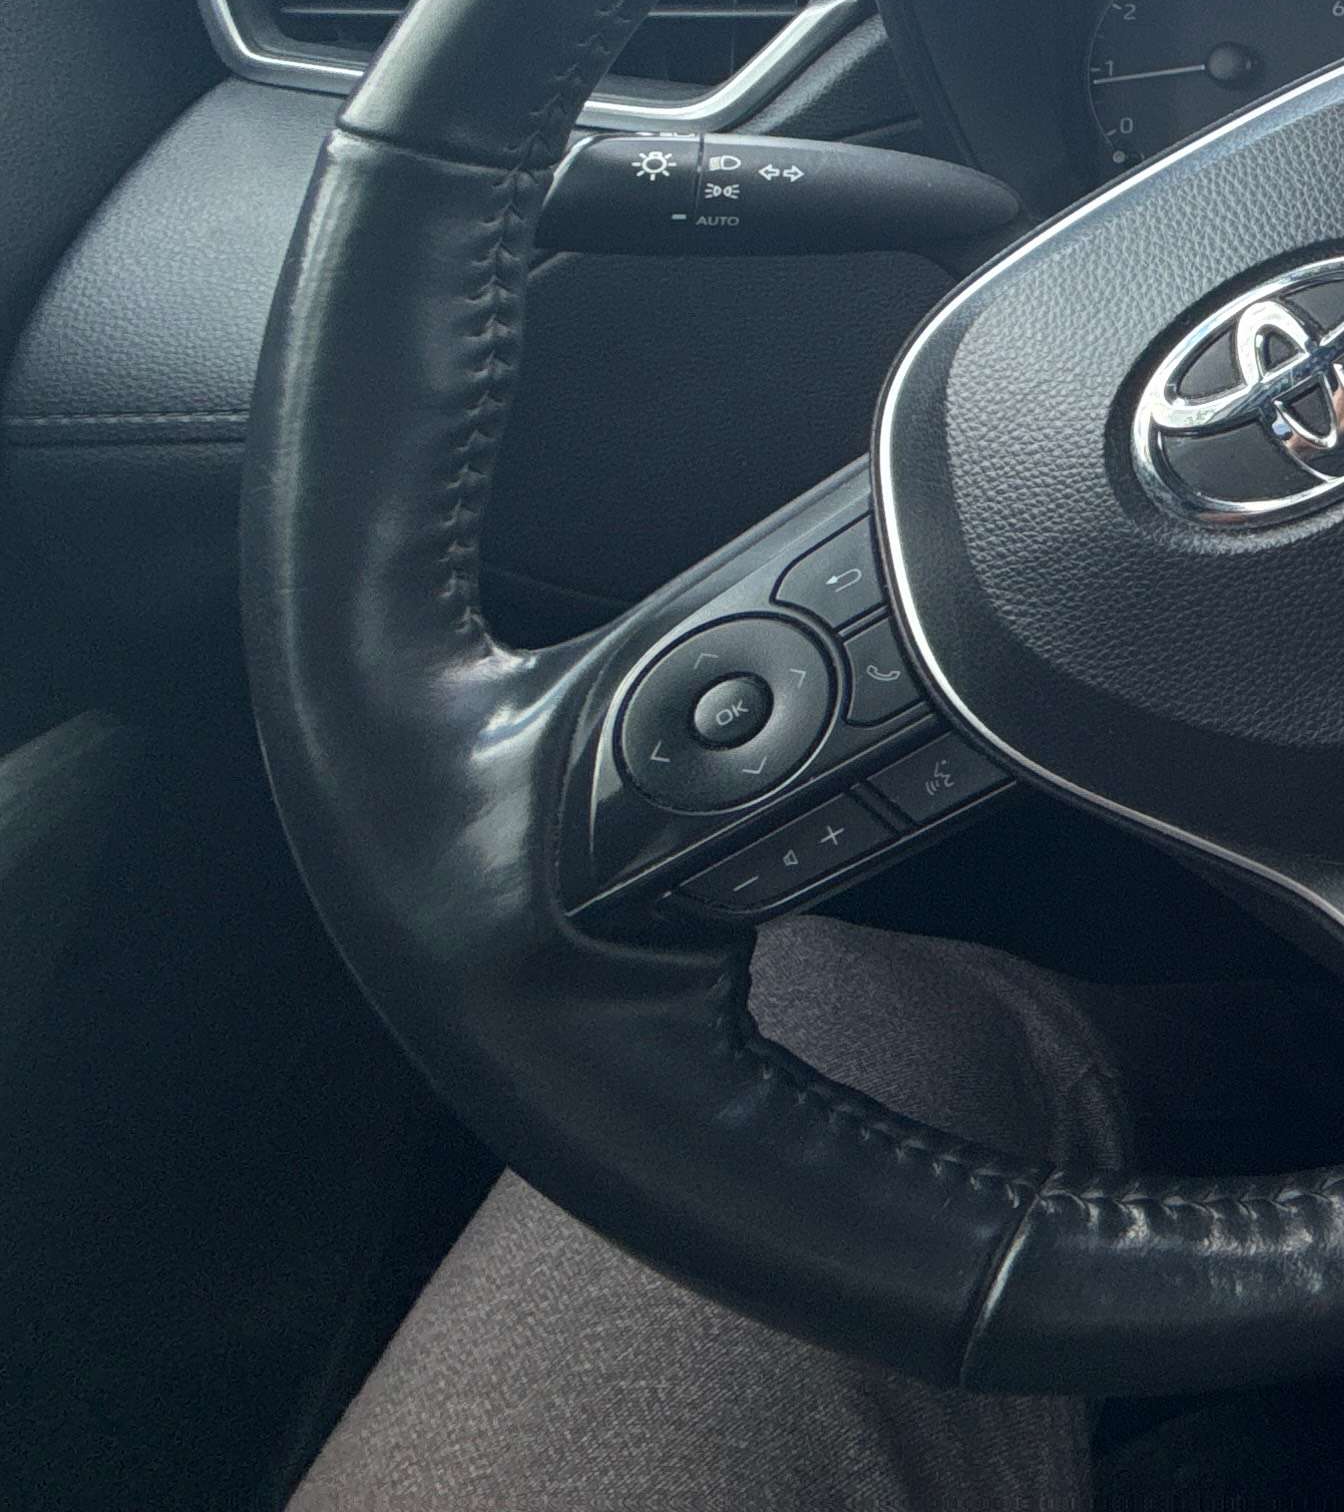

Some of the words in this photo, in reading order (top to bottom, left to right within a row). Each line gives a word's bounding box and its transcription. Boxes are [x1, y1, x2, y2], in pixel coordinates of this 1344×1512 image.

[1123, 2, 1137, 20] 2
[1105, 60, 1114, 77] 1
[1119, 116, 1134, 134] 0
[695, 215, 740, 227] AUTO
[716, 700, 749, 726] OK
